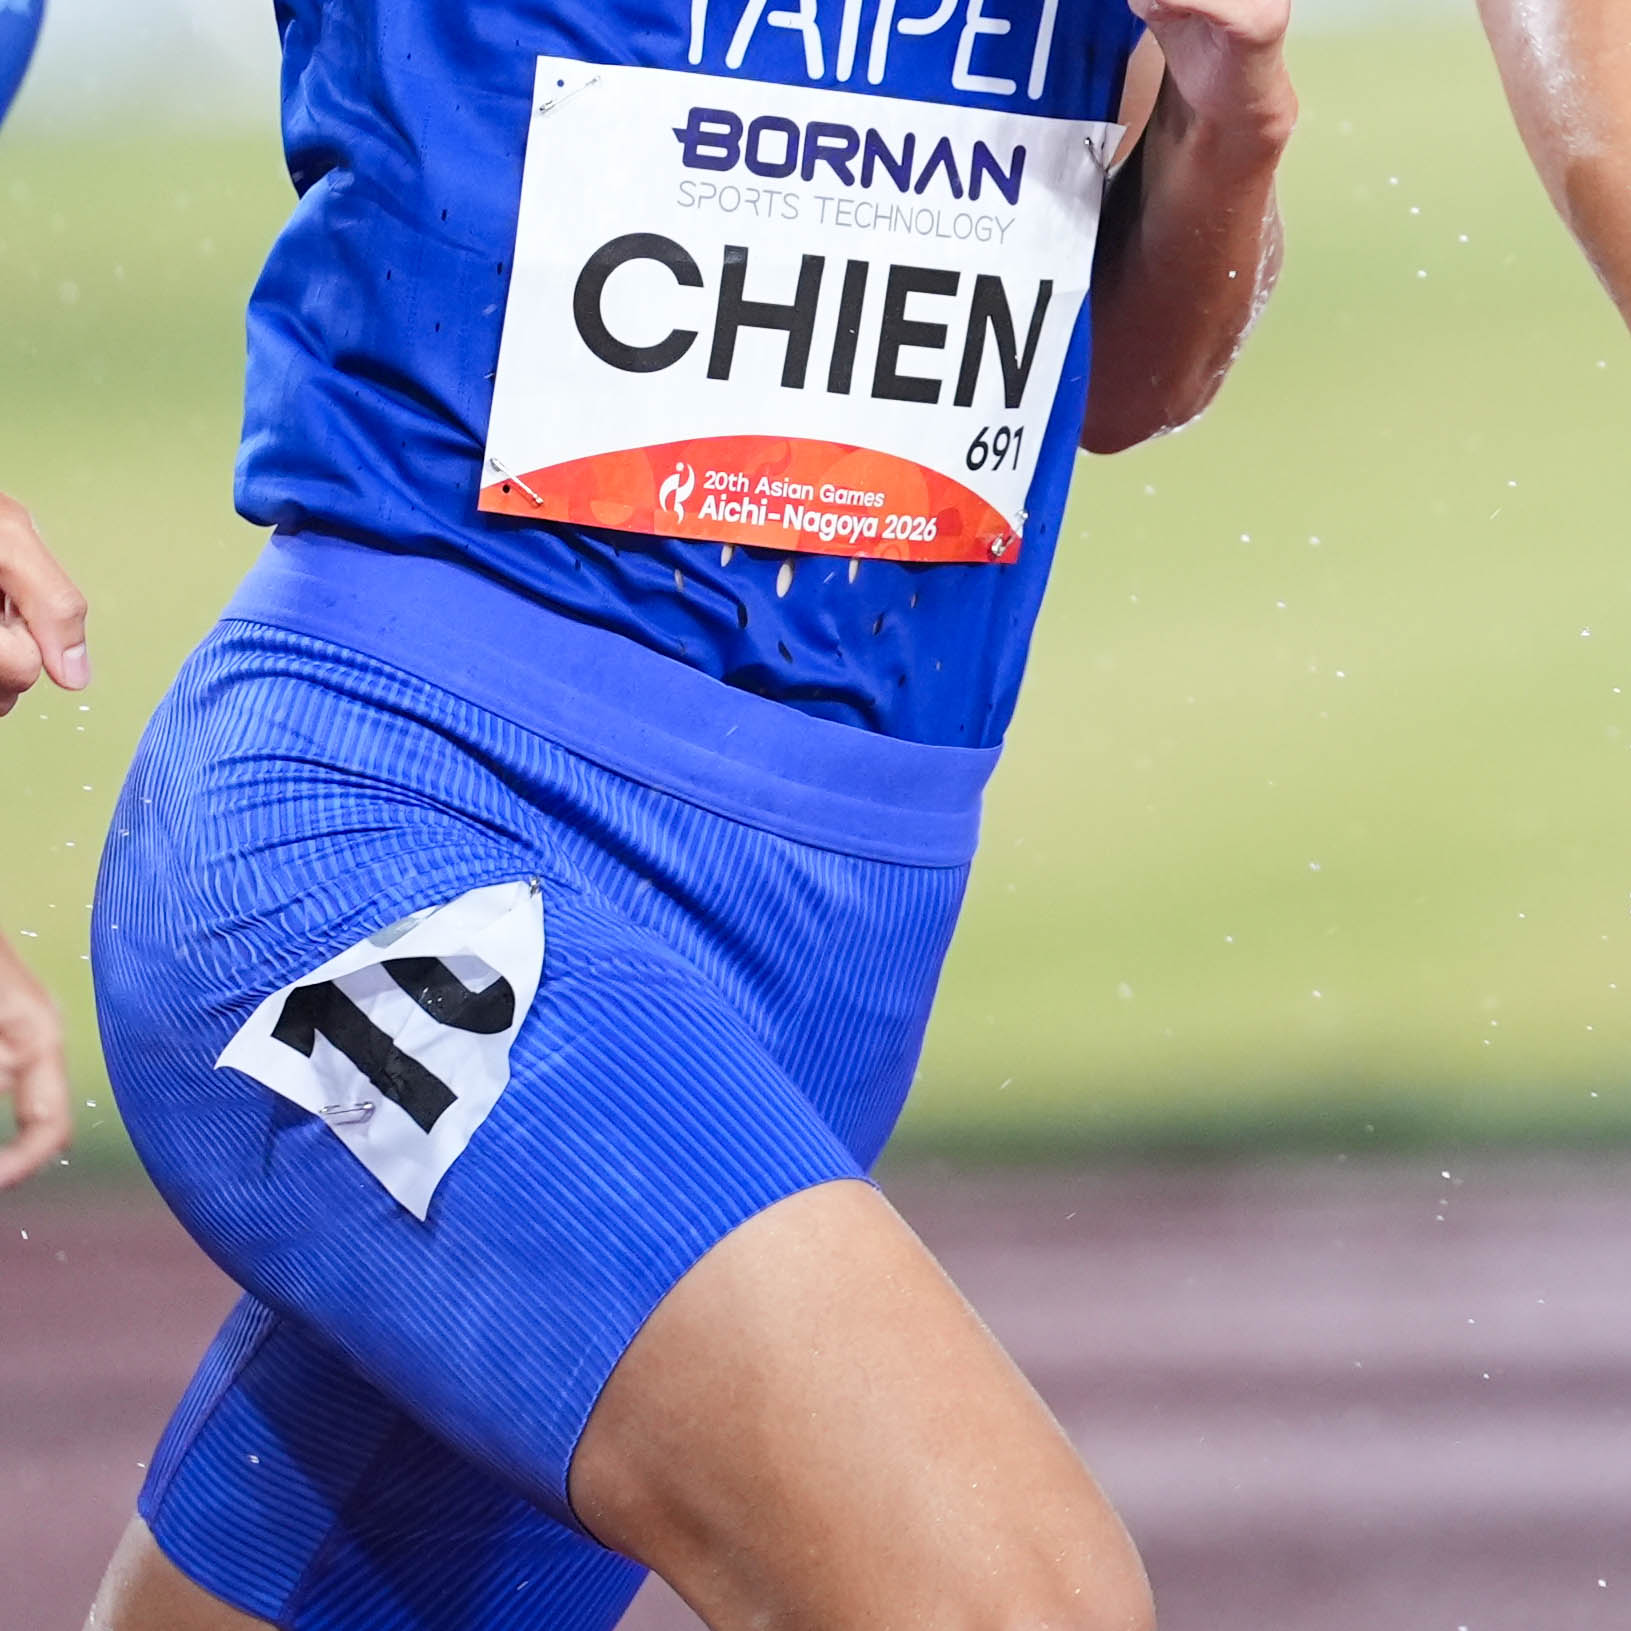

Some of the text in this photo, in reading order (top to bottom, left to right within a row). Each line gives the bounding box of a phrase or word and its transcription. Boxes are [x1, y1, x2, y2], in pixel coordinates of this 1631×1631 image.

[671, 106, 1026, 206] BORNAN
[677, 180, 1016, 245] SPORTS TECHNOLOGY
[572, 232, 1055, 409] CHIEN
[966, 425, 1024, 472] 691
[703, 470, 886, 508] 20th Asian Games
[698, 494, 937, 543] Aichi-Nagoya 2026
